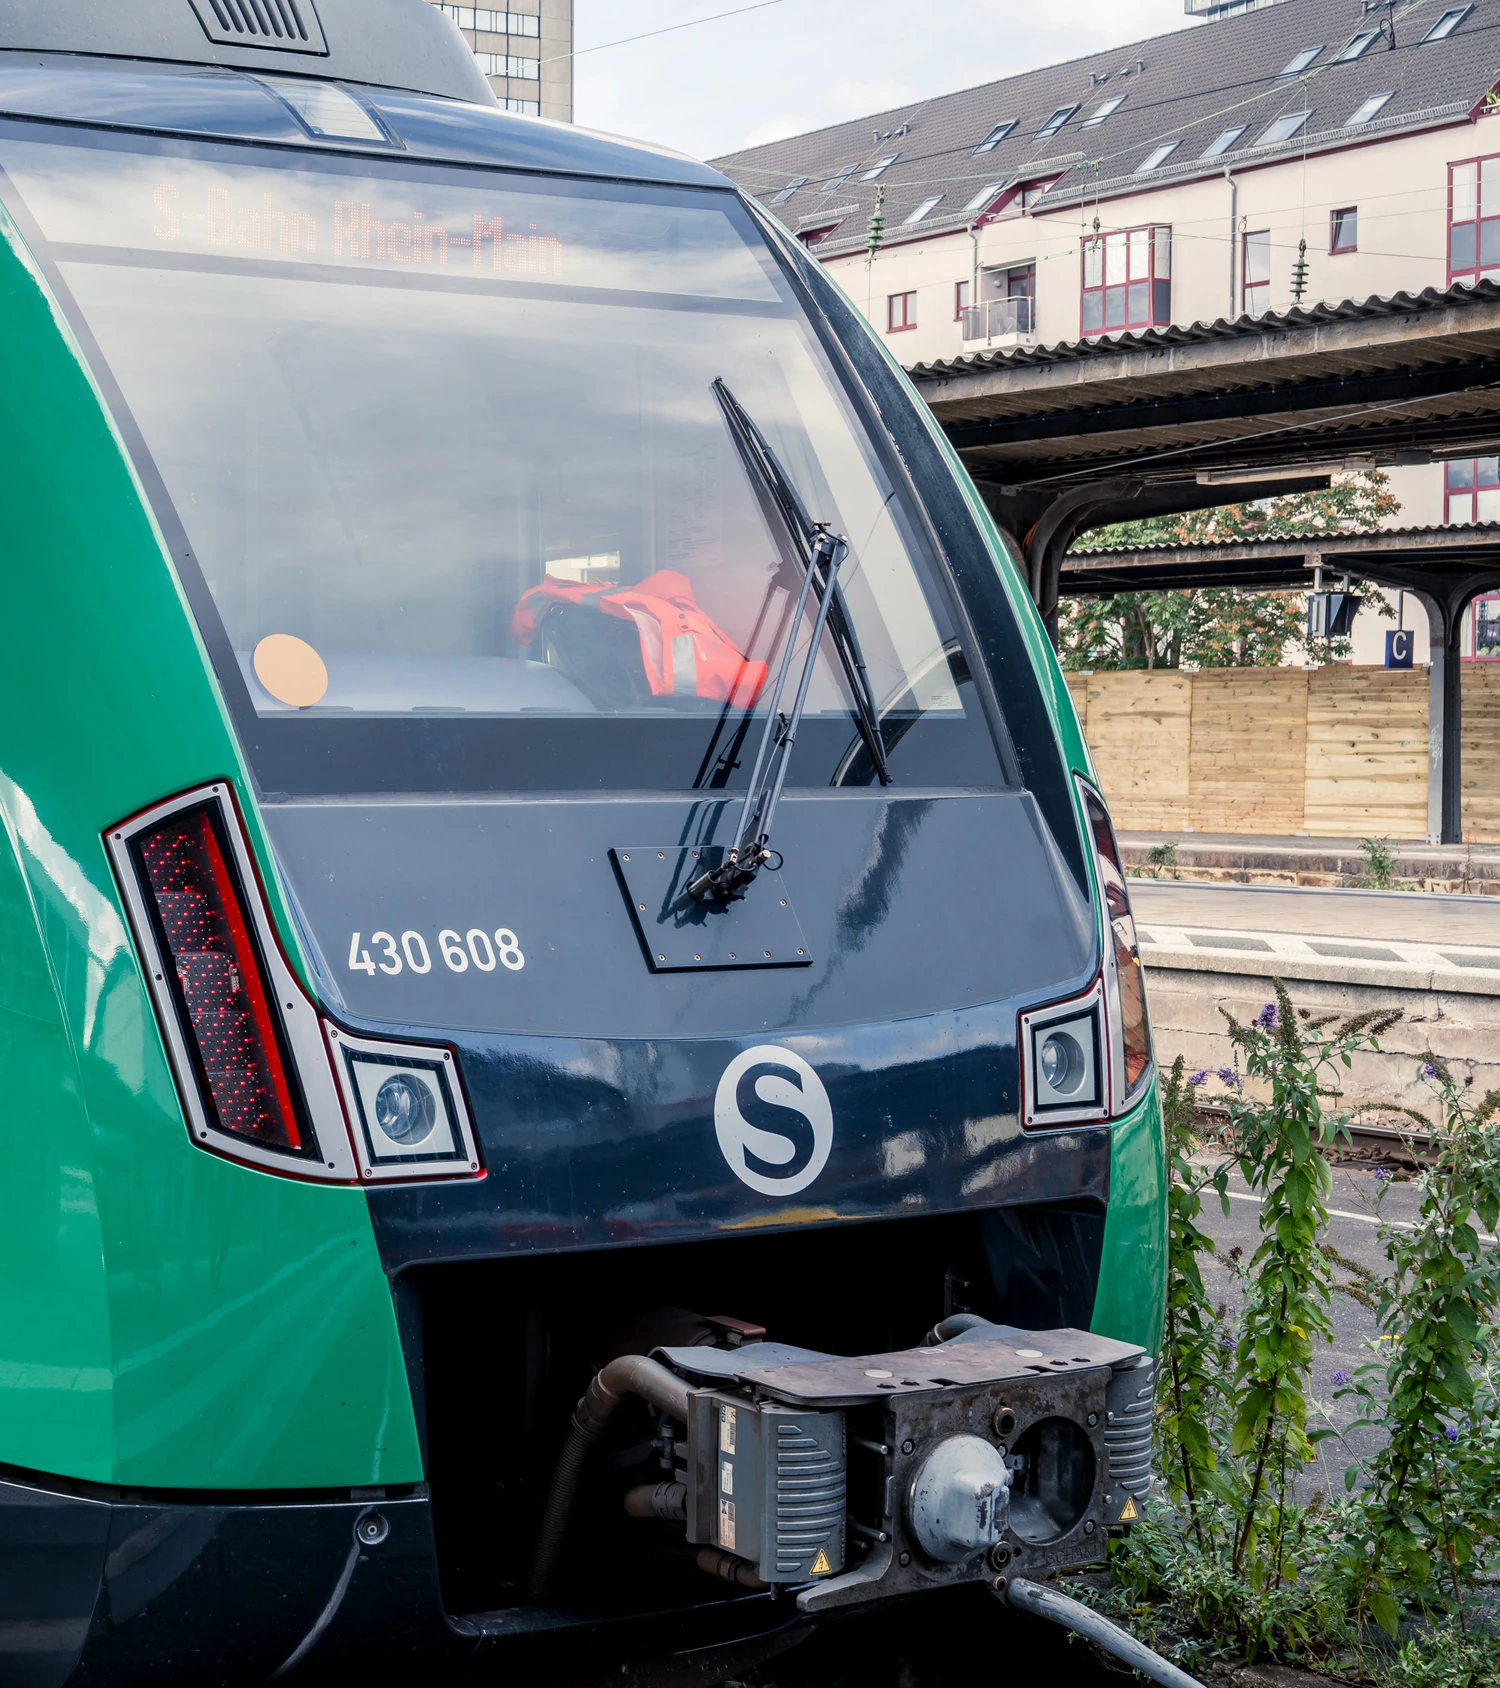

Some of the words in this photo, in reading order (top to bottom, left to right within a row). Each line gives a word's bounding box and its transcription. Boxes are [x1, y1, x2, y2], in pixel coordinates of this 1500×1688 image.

[152, 182, 317, 254] S-Bahn
[332, 199, 564, 275] Rhein-Main
[1392, 631, 1407, 660] C
[347, 928, 432, 977] 430
[438, 927, 526, 973] 608
